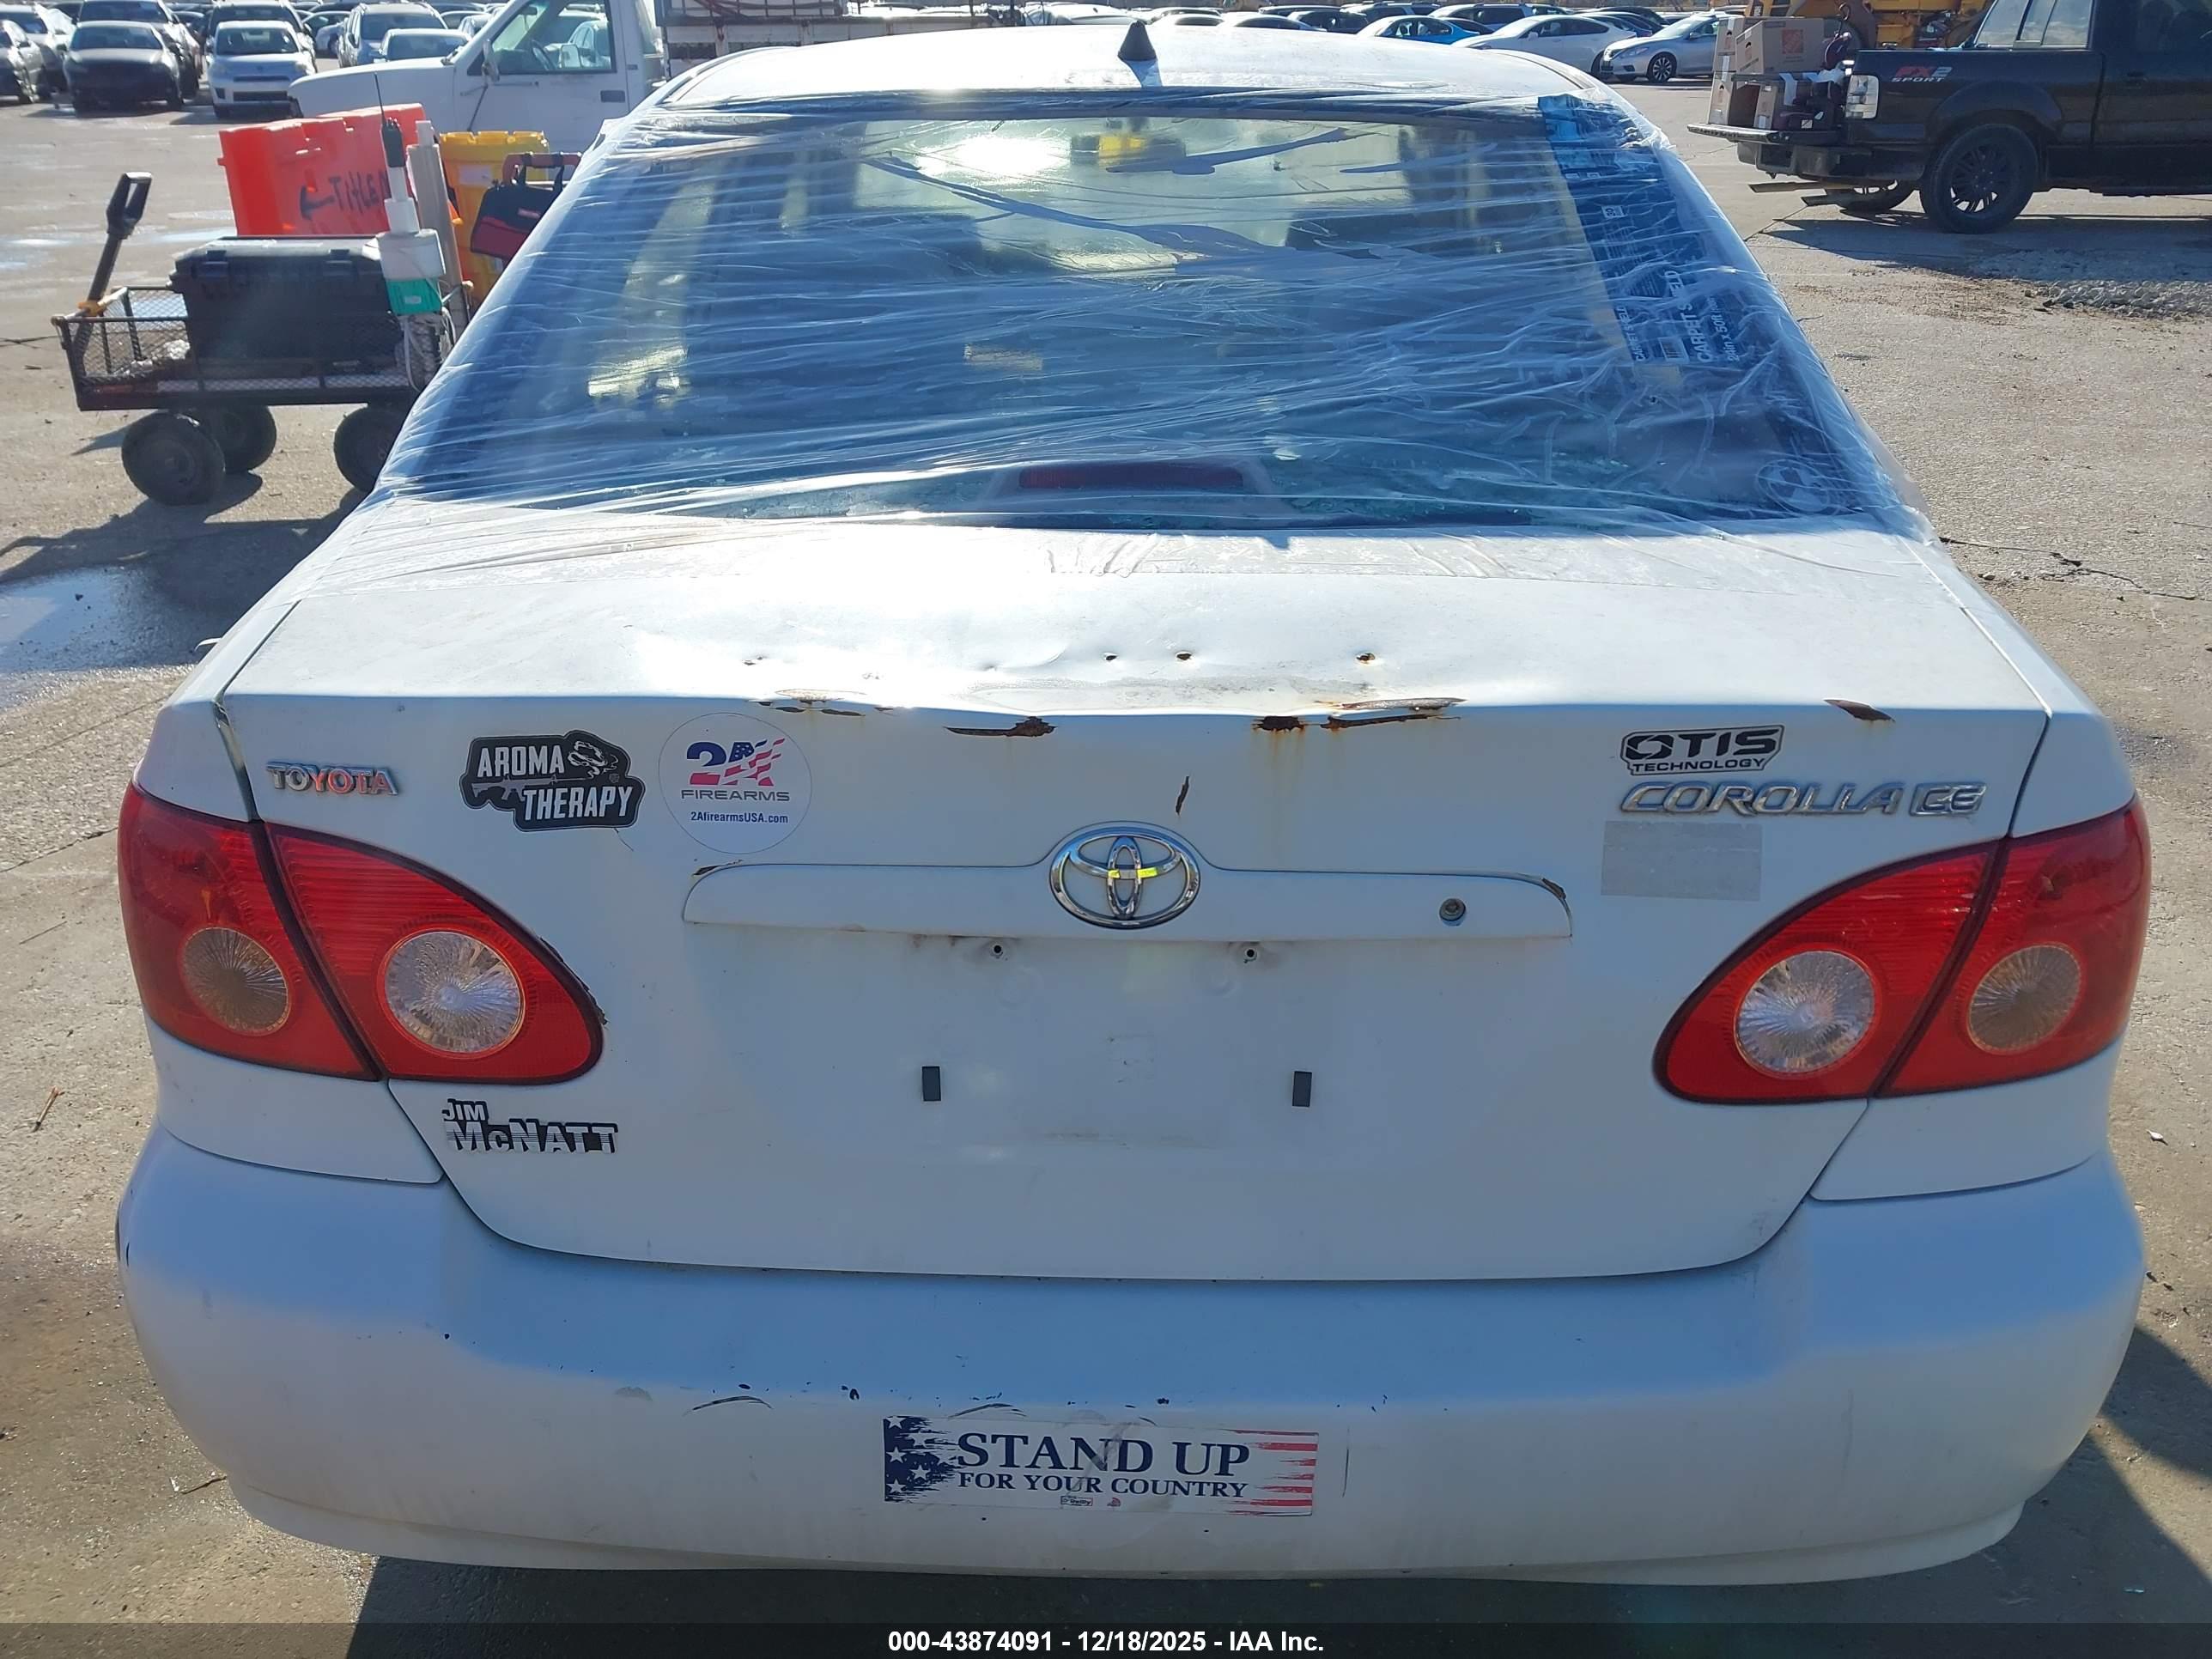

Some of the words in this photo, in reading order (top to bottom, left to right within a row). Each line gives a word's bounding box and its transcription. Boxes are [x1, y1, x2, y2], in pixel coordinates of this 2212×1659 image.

[1664, 270, 1692, 311] SELD
[1680, 313, 1714, 362] CARPET
[477, 745, 565, 778] AROMA
[1626, 730, 1780, 760] OTIS
[266, 762, 398, 795] TOYOTA
[687, 738, 785, 787] 2A
[1632, 757, 1765, 772] TECHNOLOGY
[523, 786, 633, 821] THERAPY
[681, 789, 790, 801] FIREARMS
[1620, 781, 1904, 817] COROLLA
[1911, 783, 1986, 815] CE
[690, 811, 788, 823] 2AfirearmsUSA.com
[441, 1098, 489, 1121] JIM
[444, 1119, 618, 1153] McNATT
[957, 1432, 1153, 1474] STAND
[1172, 1442, 1250, 1477] UP
[958, 1472, 1016, 1490] FOR
[1026, 1474, 1104, 1493] YOUR
[1110, 1478, 1249, 1498] COUNTRY
